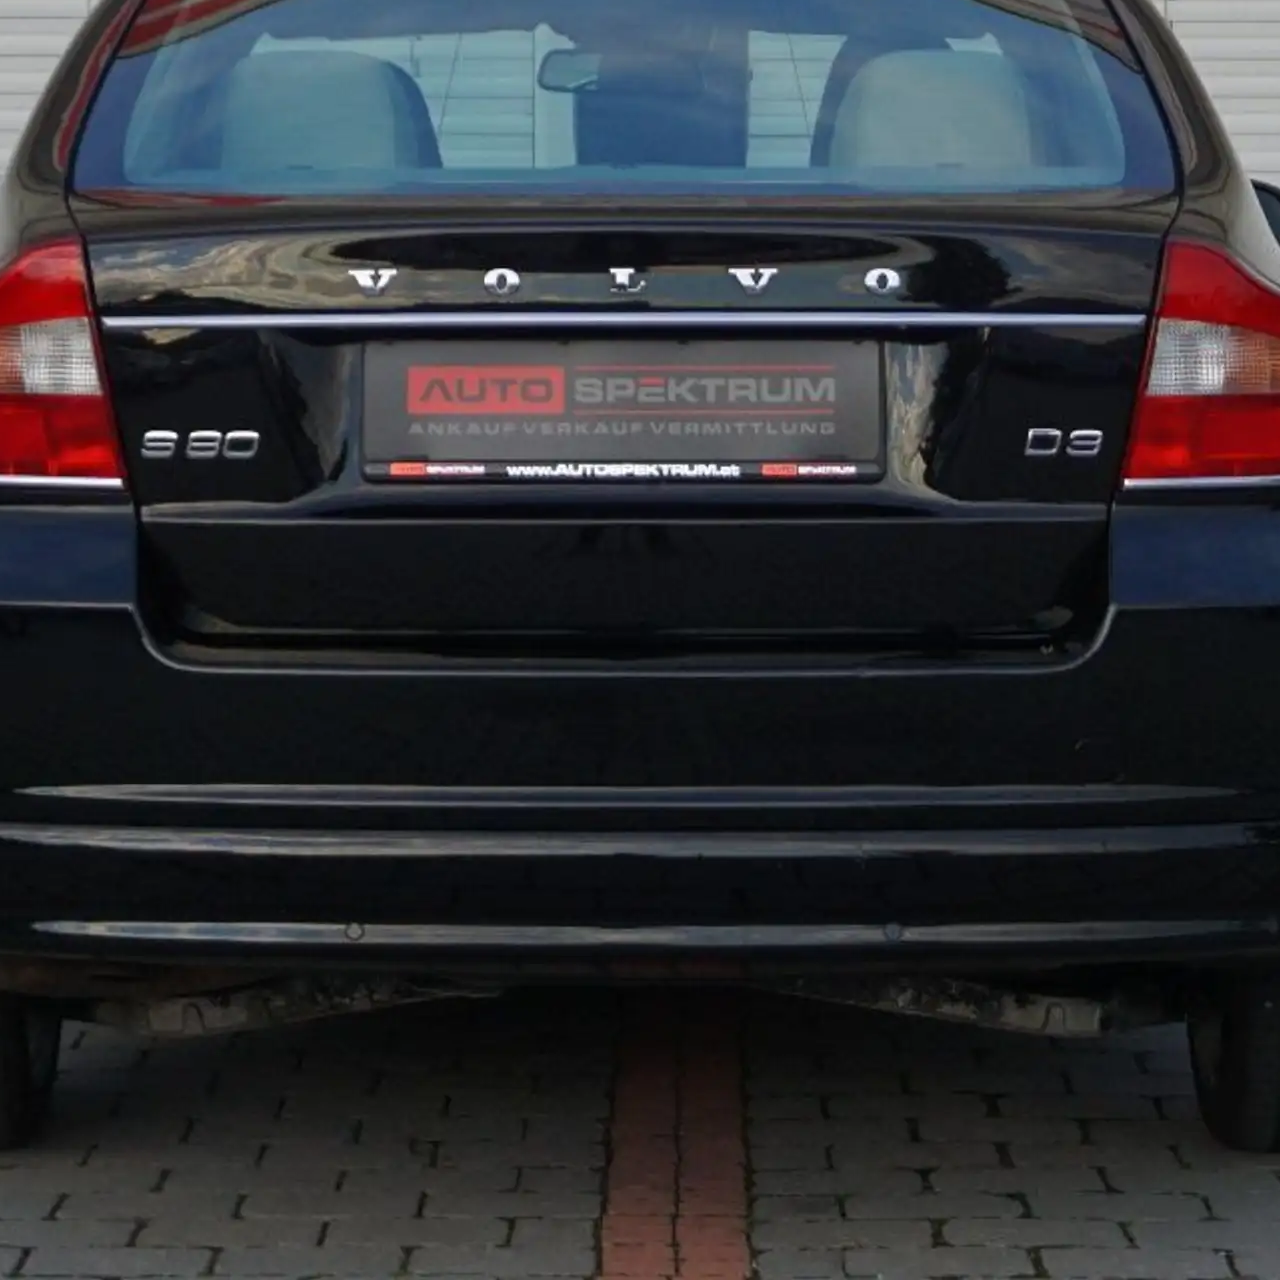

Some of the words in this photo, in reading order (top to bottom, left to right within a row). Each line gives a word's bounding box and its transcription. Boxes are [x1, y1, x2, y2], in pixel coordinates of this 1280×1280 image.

[348, 267, 902, 293] VOLVO
[419, 378, 554, 402] AUTO
[575, 377, 836, 403] SPEKTRUM
[408, 421, 517, 436] ANKAUF
[522, 421, 643, 436] VERKAUF
[649, 421, 836, 436] VERMITTLUNG
[140, 429, 260, 459] S80
[1024, 428, 1104, 456] D3
[506, 463, 741, 478] www.AUTOSPEKTRUM.at
